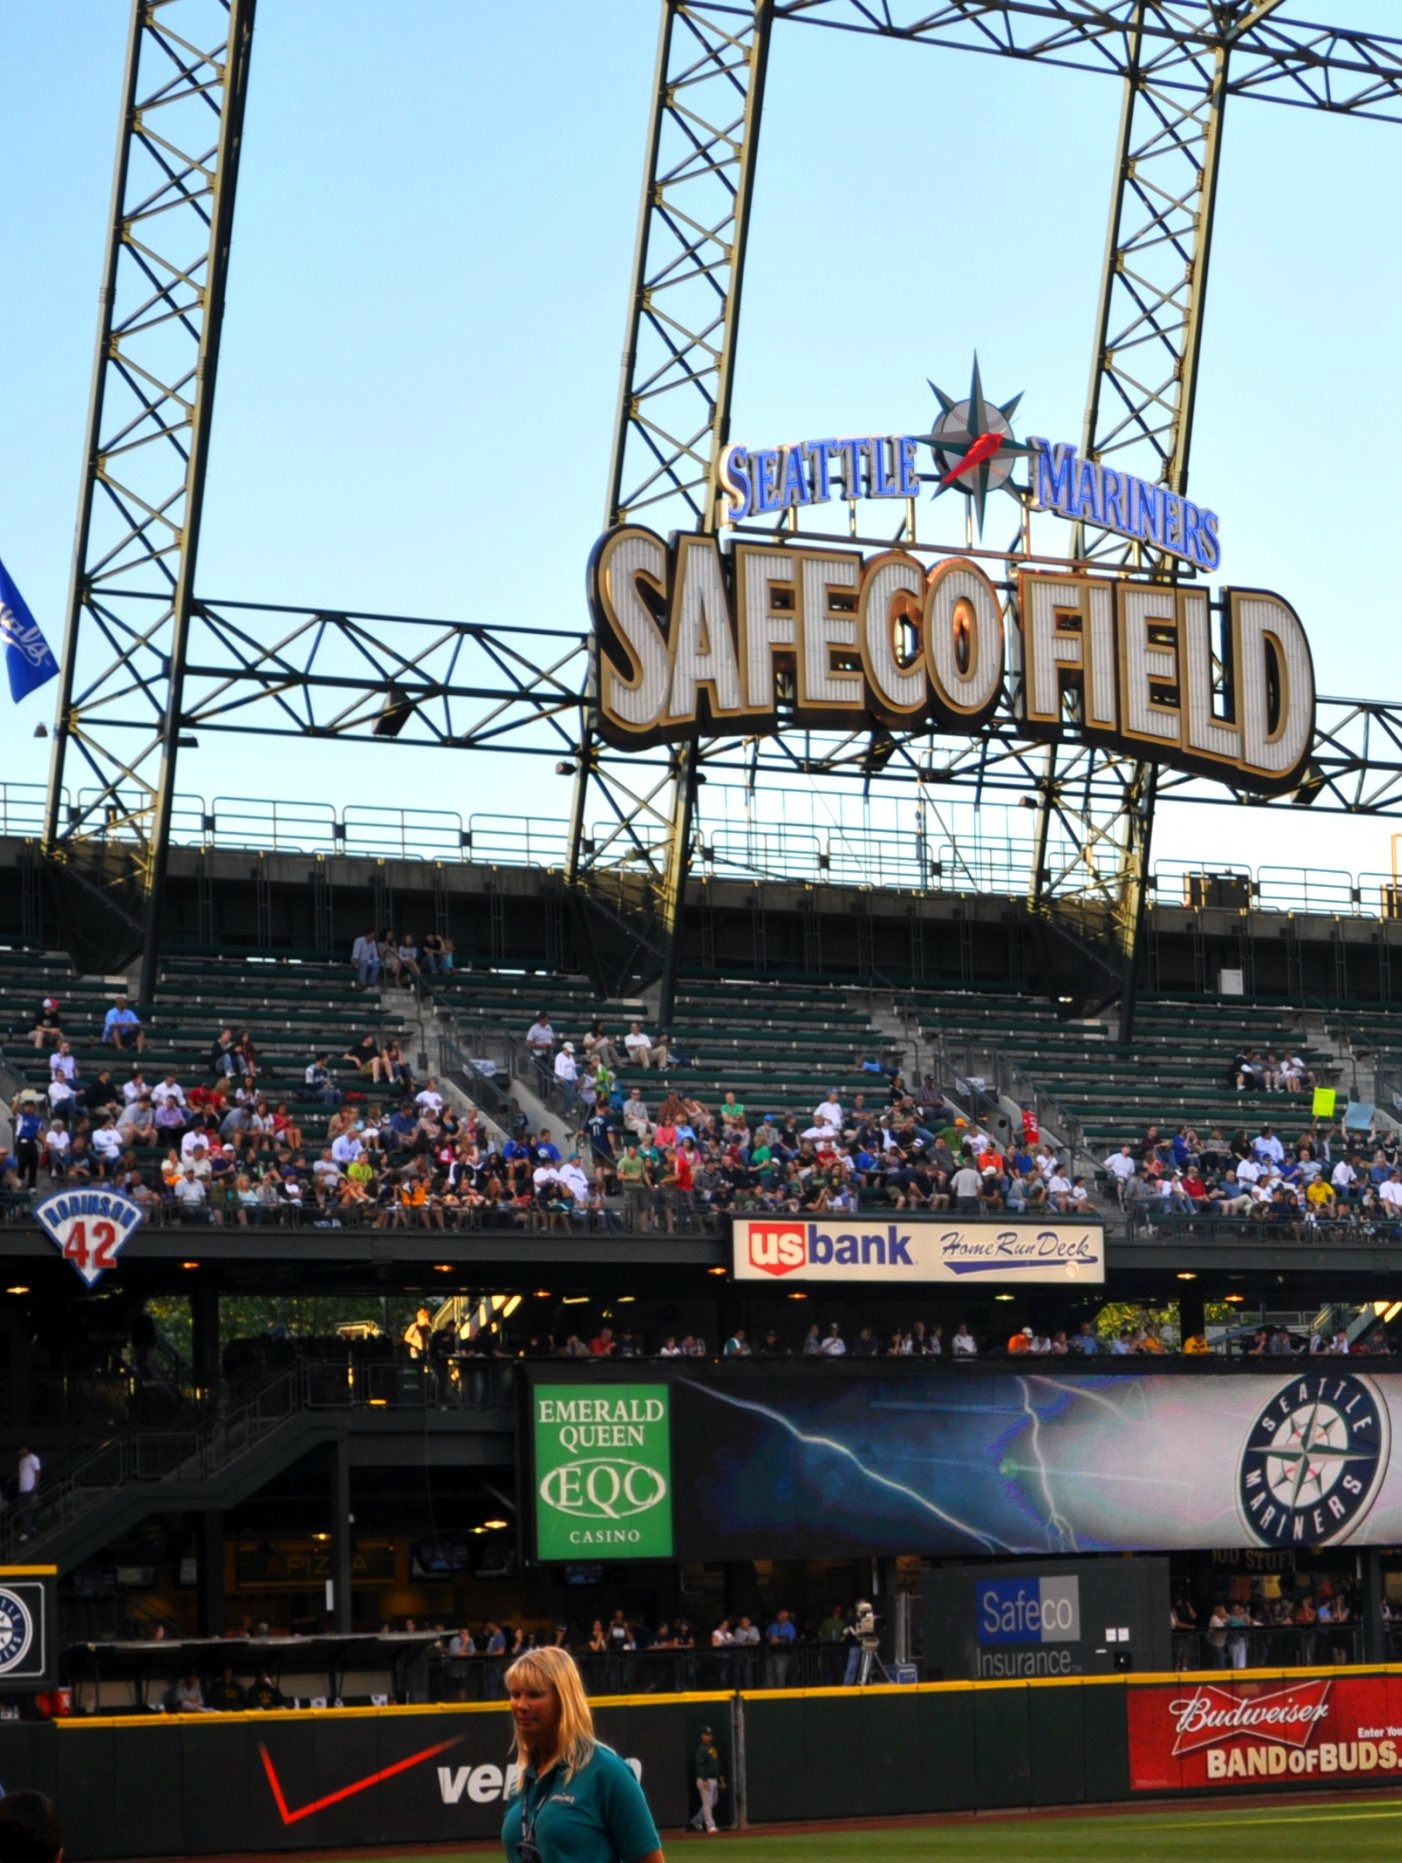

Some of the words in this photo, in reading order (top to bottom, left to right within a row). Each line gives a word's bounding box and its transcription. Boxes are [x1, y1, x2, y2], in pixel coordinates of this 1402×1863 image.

[719, 435, 920, 523] SEATTLE
[1026, 436, 1222, 572] MARINERS
[587, 523, 1004, 750] SAFECO
[1019, 568, 1316, 793] FIELD
[63, 1220, 117, 1268] 42
[538, 1398, 665, 1423] EMERALD
[1262, 1378, 1372, 1433] SEATTLE
[559, 1425, 645, 1454] QUEEN
[553, 1465, 656, 1519] EQC
[1245, 1469, 1362, 1541] MARINERS
[569, 1529, 641, 1544] CASINO
[982, 1590, 1073, 1632] Safeco
[976, 1647, 1071, 1678] Insurance
[1169, 1698, 1329, 1733] Budweiser
[1357, 1727, 1385, 1739] Enter
